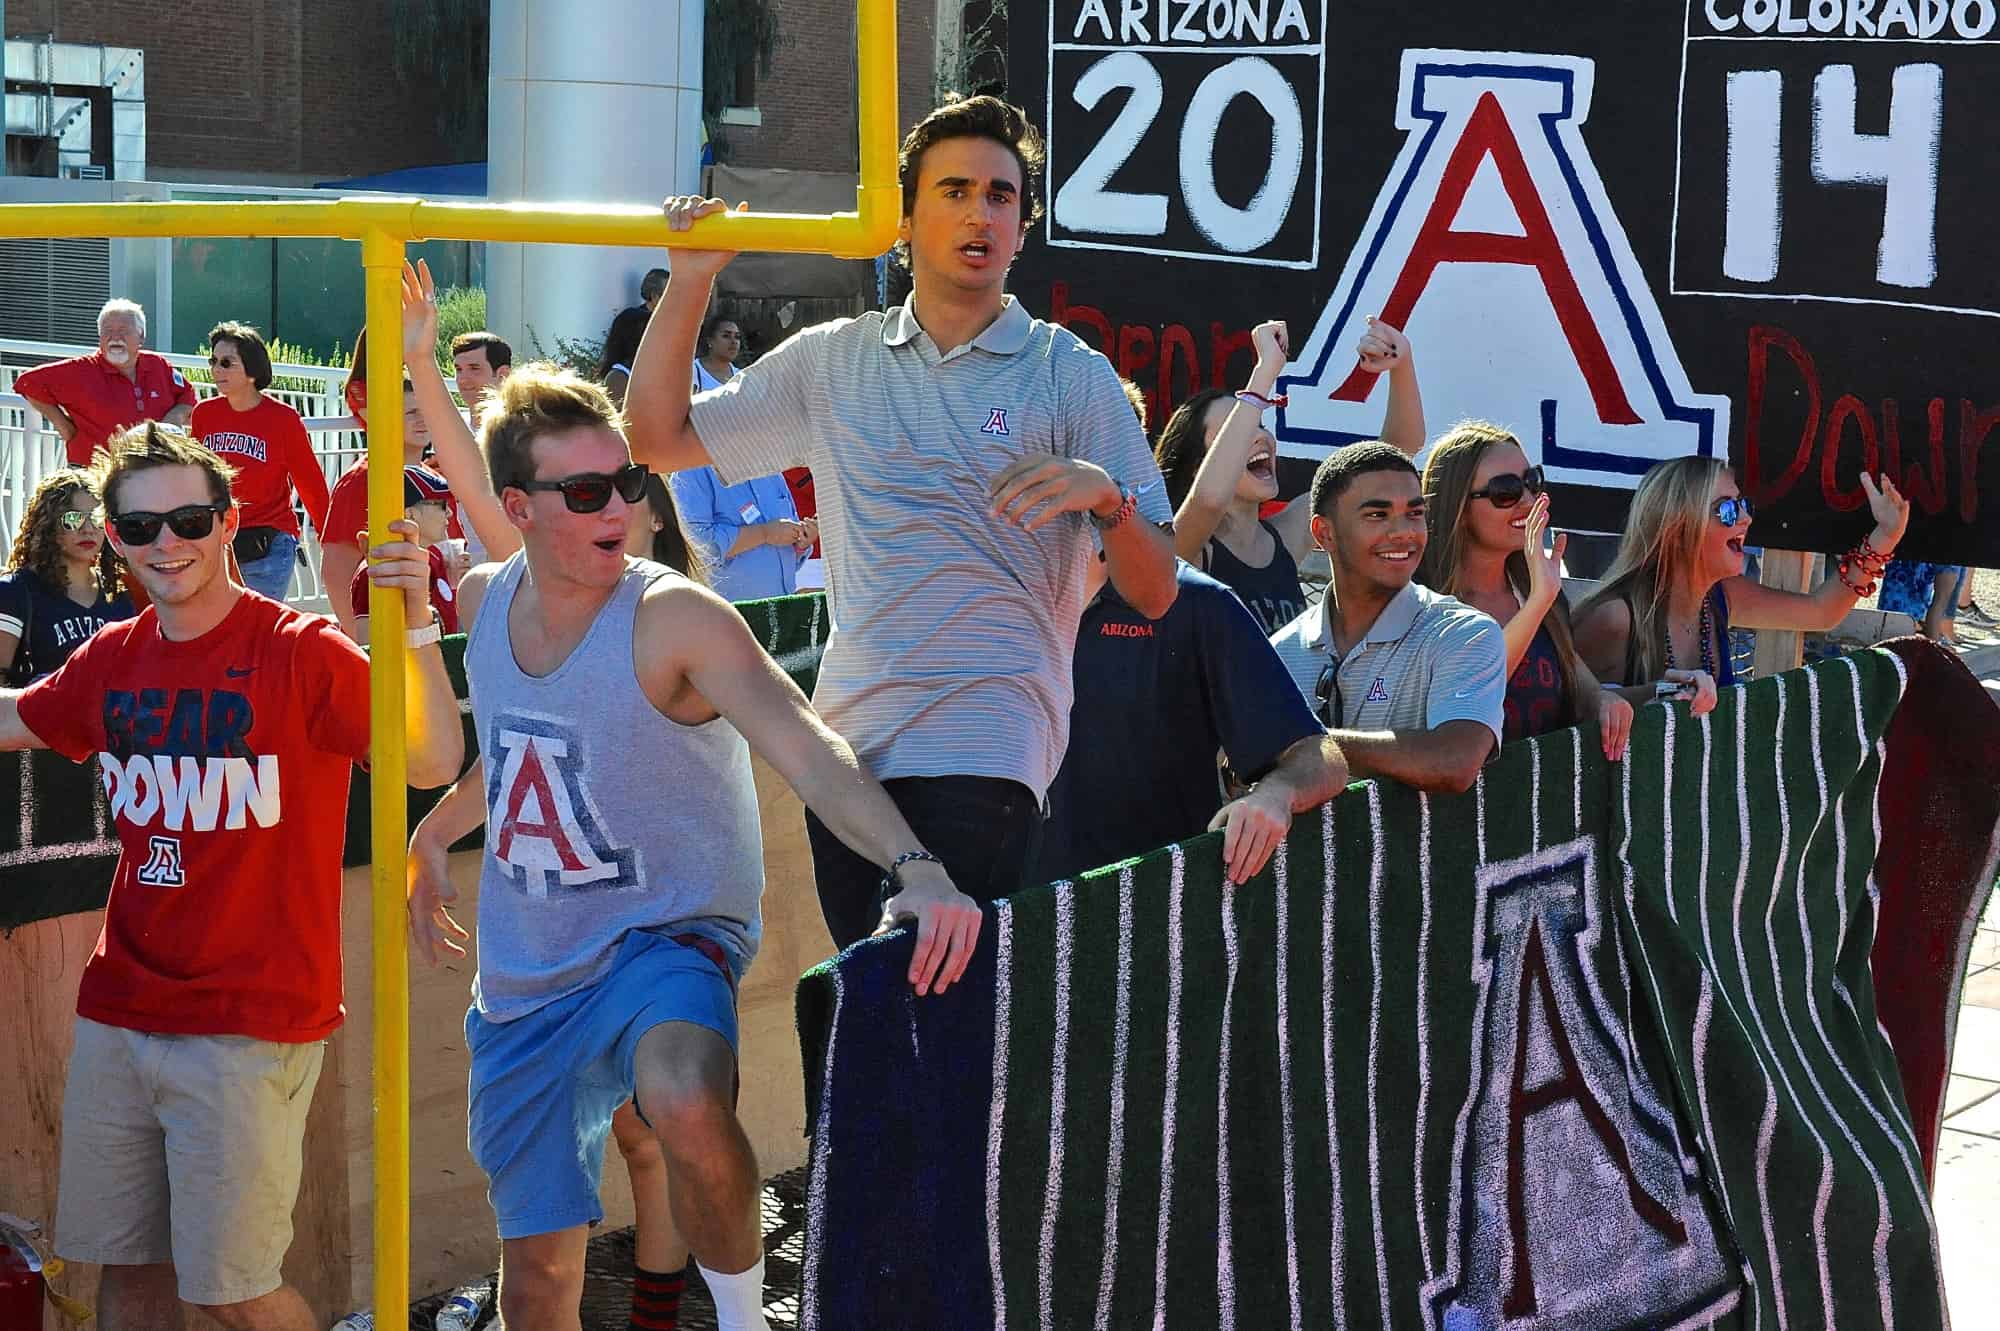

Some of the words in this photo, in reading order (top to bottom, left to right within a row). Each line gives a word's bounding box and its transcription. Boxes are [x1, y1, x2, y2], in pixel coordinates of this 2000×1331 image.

[1073, 0, 1310, 43] ARIZONA
[1704, 0, 1997, 38] COLORADO
[1054, 51, 1304, 253] 20
[1723, 62, 1944, 288] 14
[1277, 48, 1731, 489] A
[203, 431, 267, 463] ARIZONA
[980, 407, 1010, 436] A
[1100, 623, 1153, 638] ARIZONA
[1366, 677, 1388, 701] A
[102, 689, 256, 762] BEAR
[100, 751, 281, 831] DOWN
[487, 707, 648, 897] A
[138, 835, 185, 887] A
